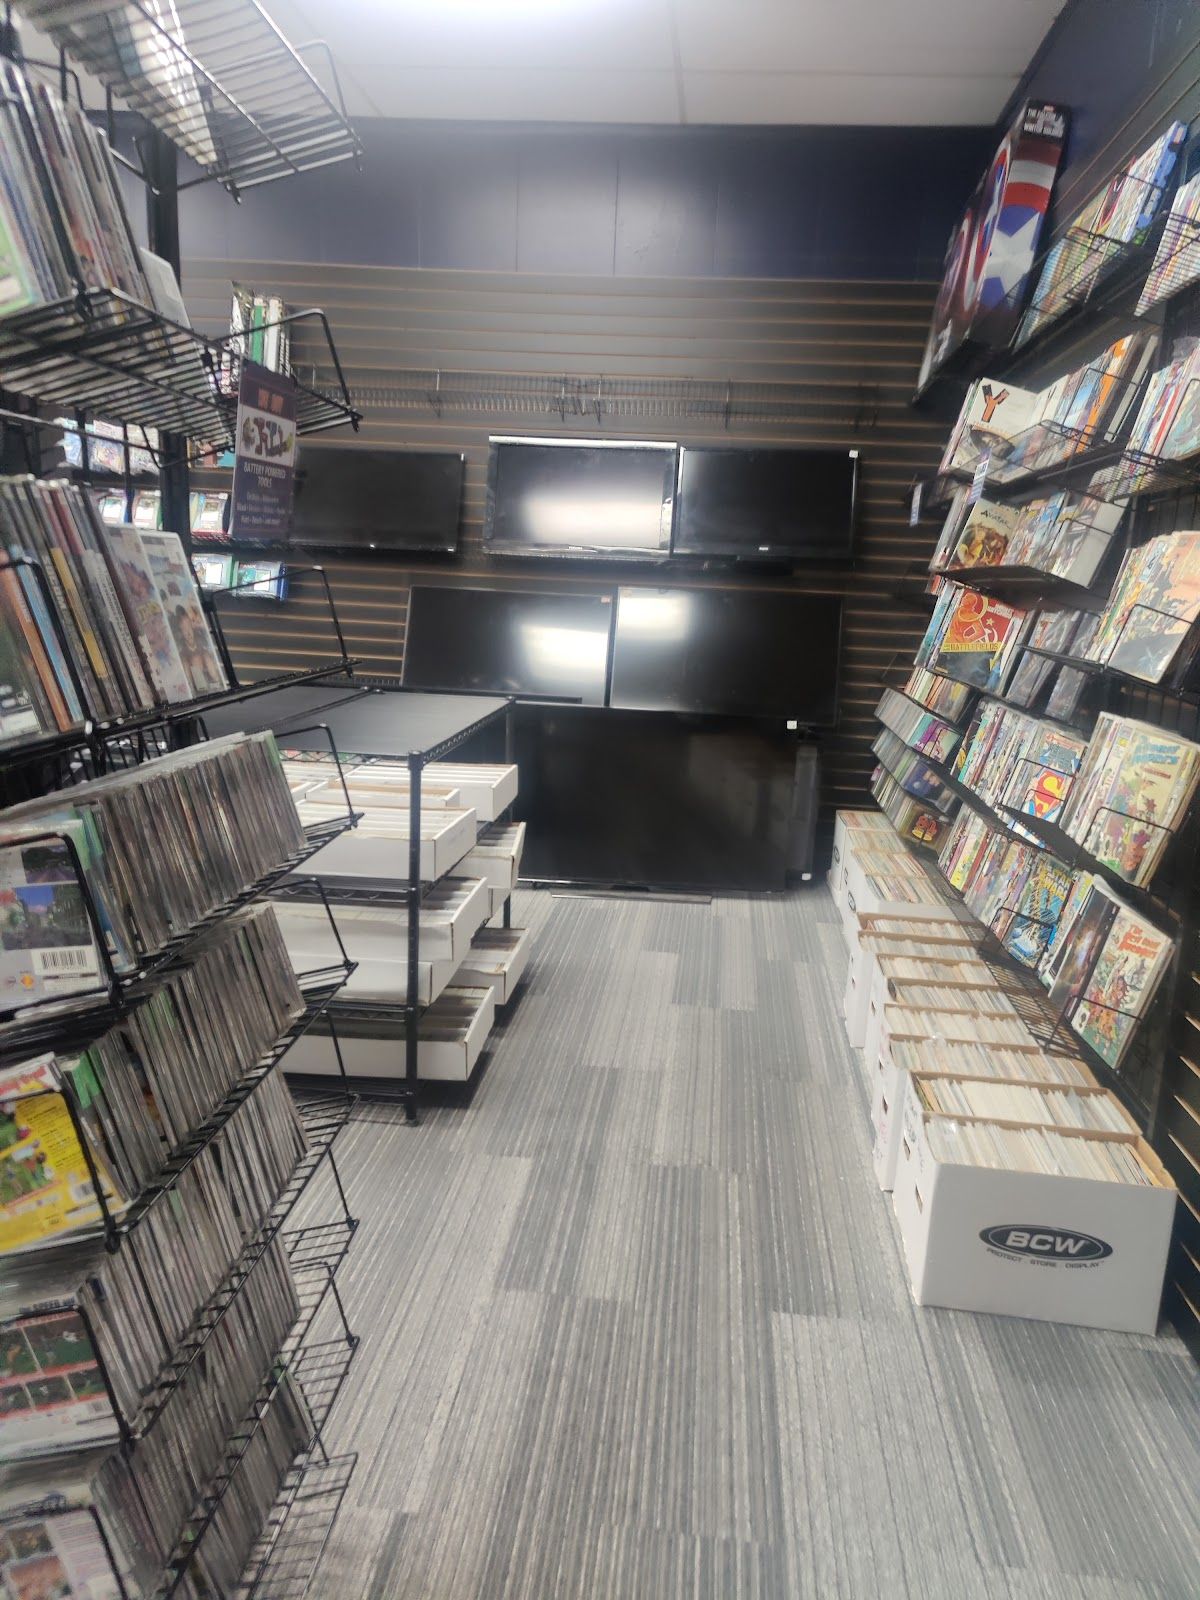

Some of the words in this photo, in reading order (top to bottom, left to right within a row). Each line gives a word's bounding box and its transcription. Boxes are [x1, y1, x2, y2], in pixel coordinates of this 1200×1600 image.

[1005, 1230, 1086, 1254] BCW
[986, 1247, 1022, 1263] PROTECT
[1030, 1259, 1057, 1268] STORE
